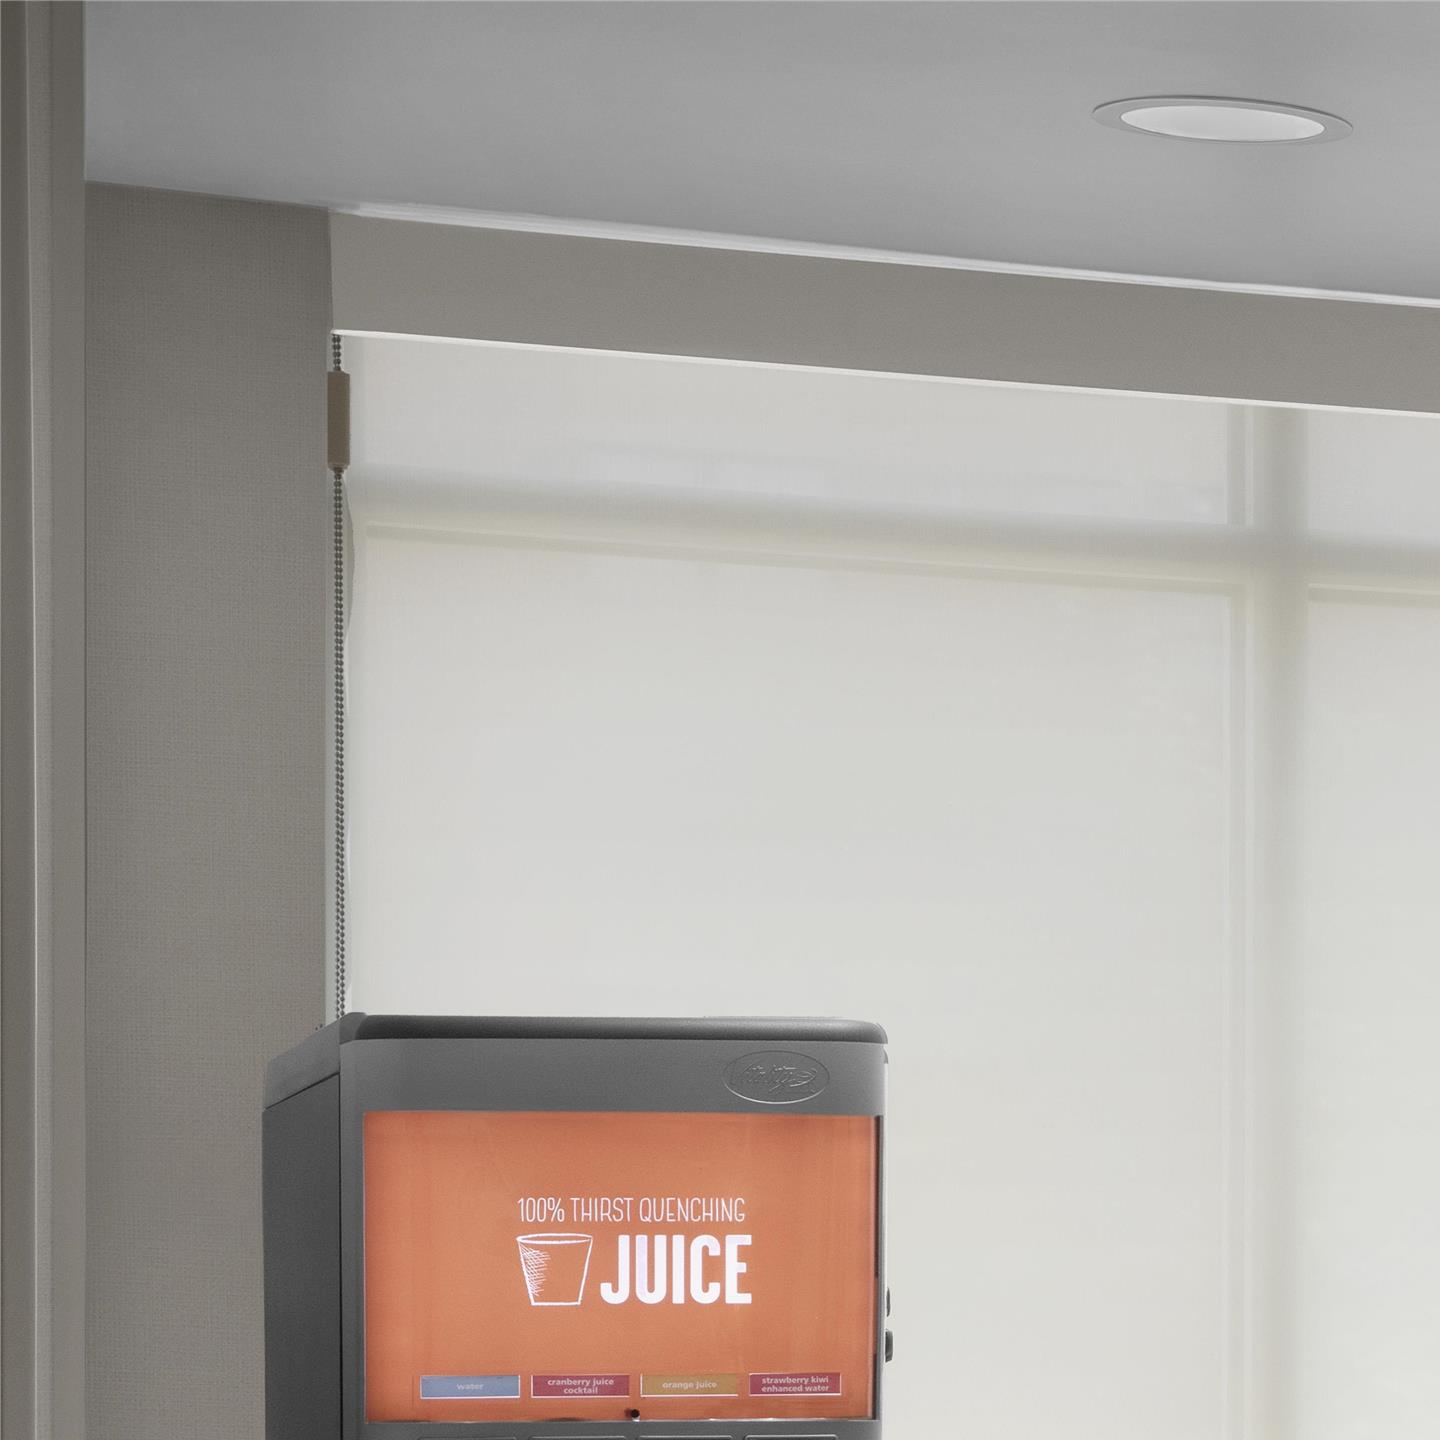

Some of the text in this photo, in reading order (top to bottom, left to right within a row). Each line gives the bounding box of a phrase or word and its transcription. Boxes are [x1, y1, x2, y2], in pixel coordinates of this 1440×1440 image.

[517, 1197, 745, 1223] 100% THIRST QUENCHING
[600, 1234, 752, 1304] JUICE
[547, 1377, 614, 1387] cranberry juice
[662, 1380, 717, 1390] orange juice
[762, 1376, 829, 1385] strawberry kiwi
[457, 1383, 484, 1391] water
[564, 1386, 598, 1394] cocktail
[762, 1385, 830, 1393] enhanced water
